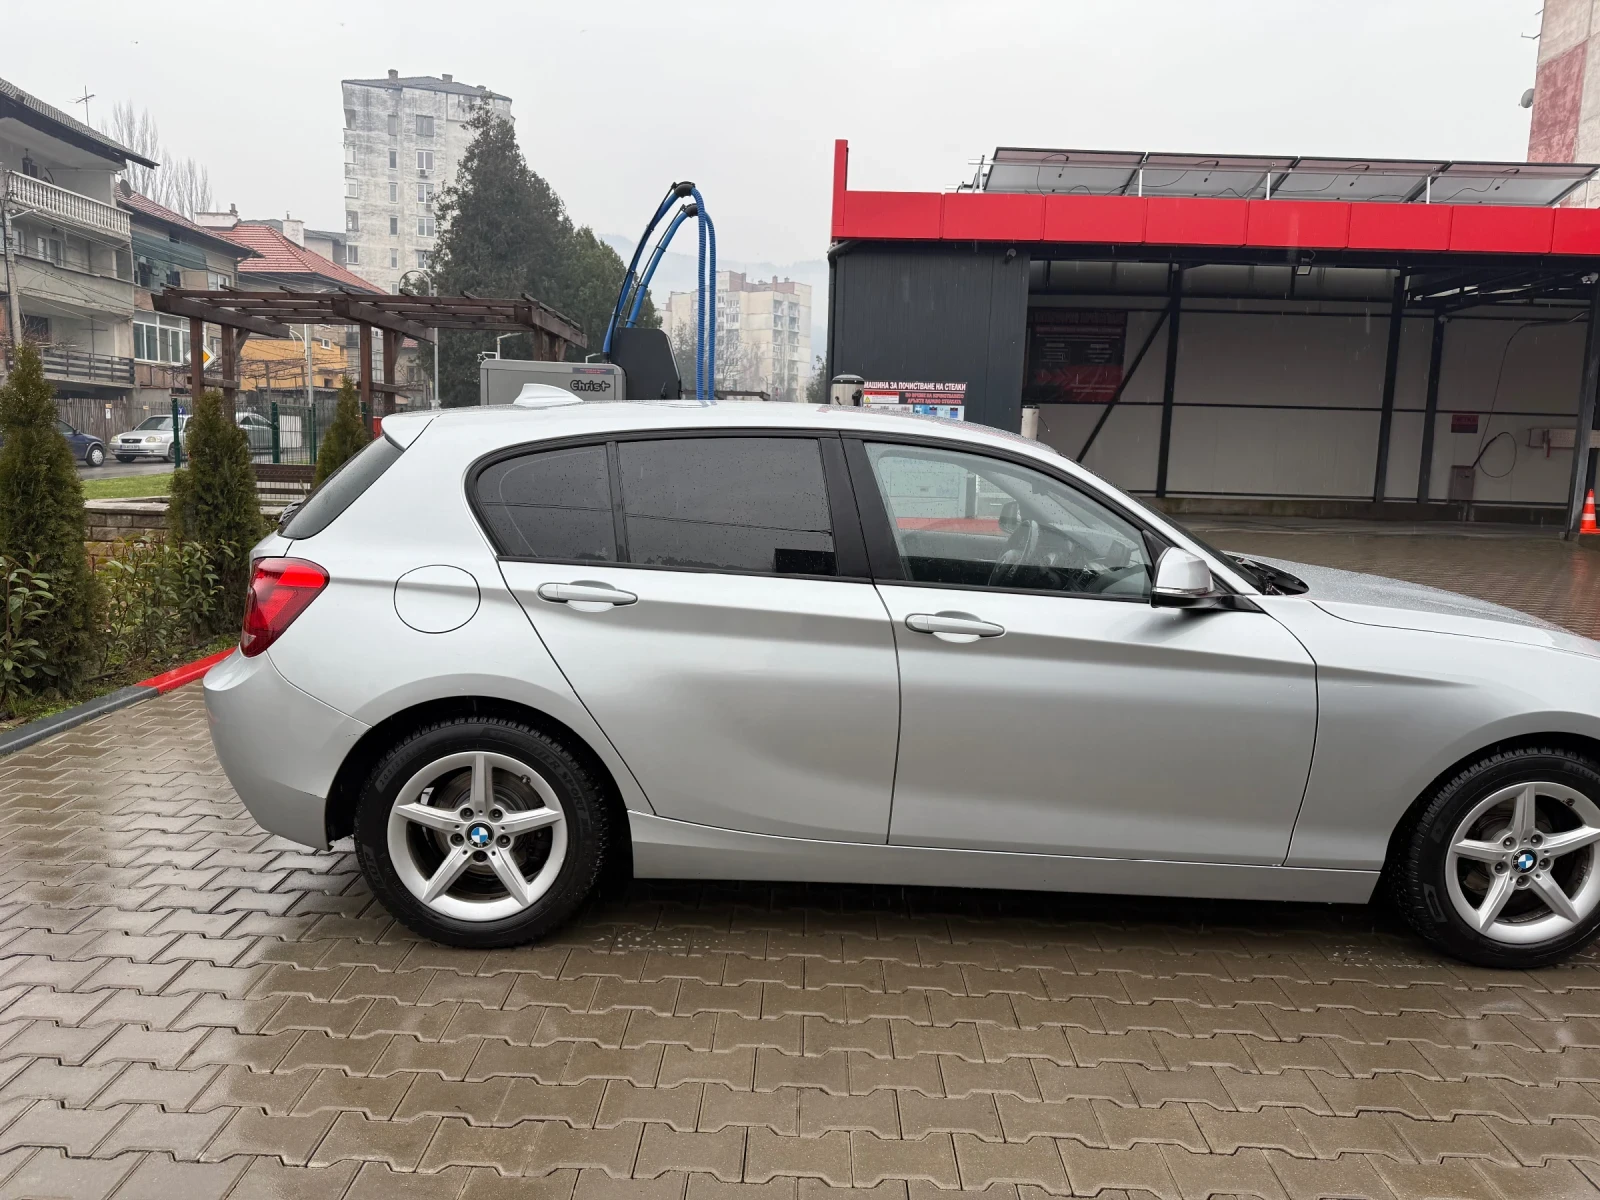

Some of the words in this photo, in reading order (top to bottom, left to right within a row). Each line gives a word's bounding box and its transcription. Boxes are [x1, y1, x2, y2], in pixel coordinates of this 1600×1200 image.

[570, 380, 610, 392] Christ
[864, 381, 889, 389] МАШИНА
[898, 382, 935, 390] ПОЧИСТВАНЕ
[944, 383, 966, 391] СТЕЛКИ
